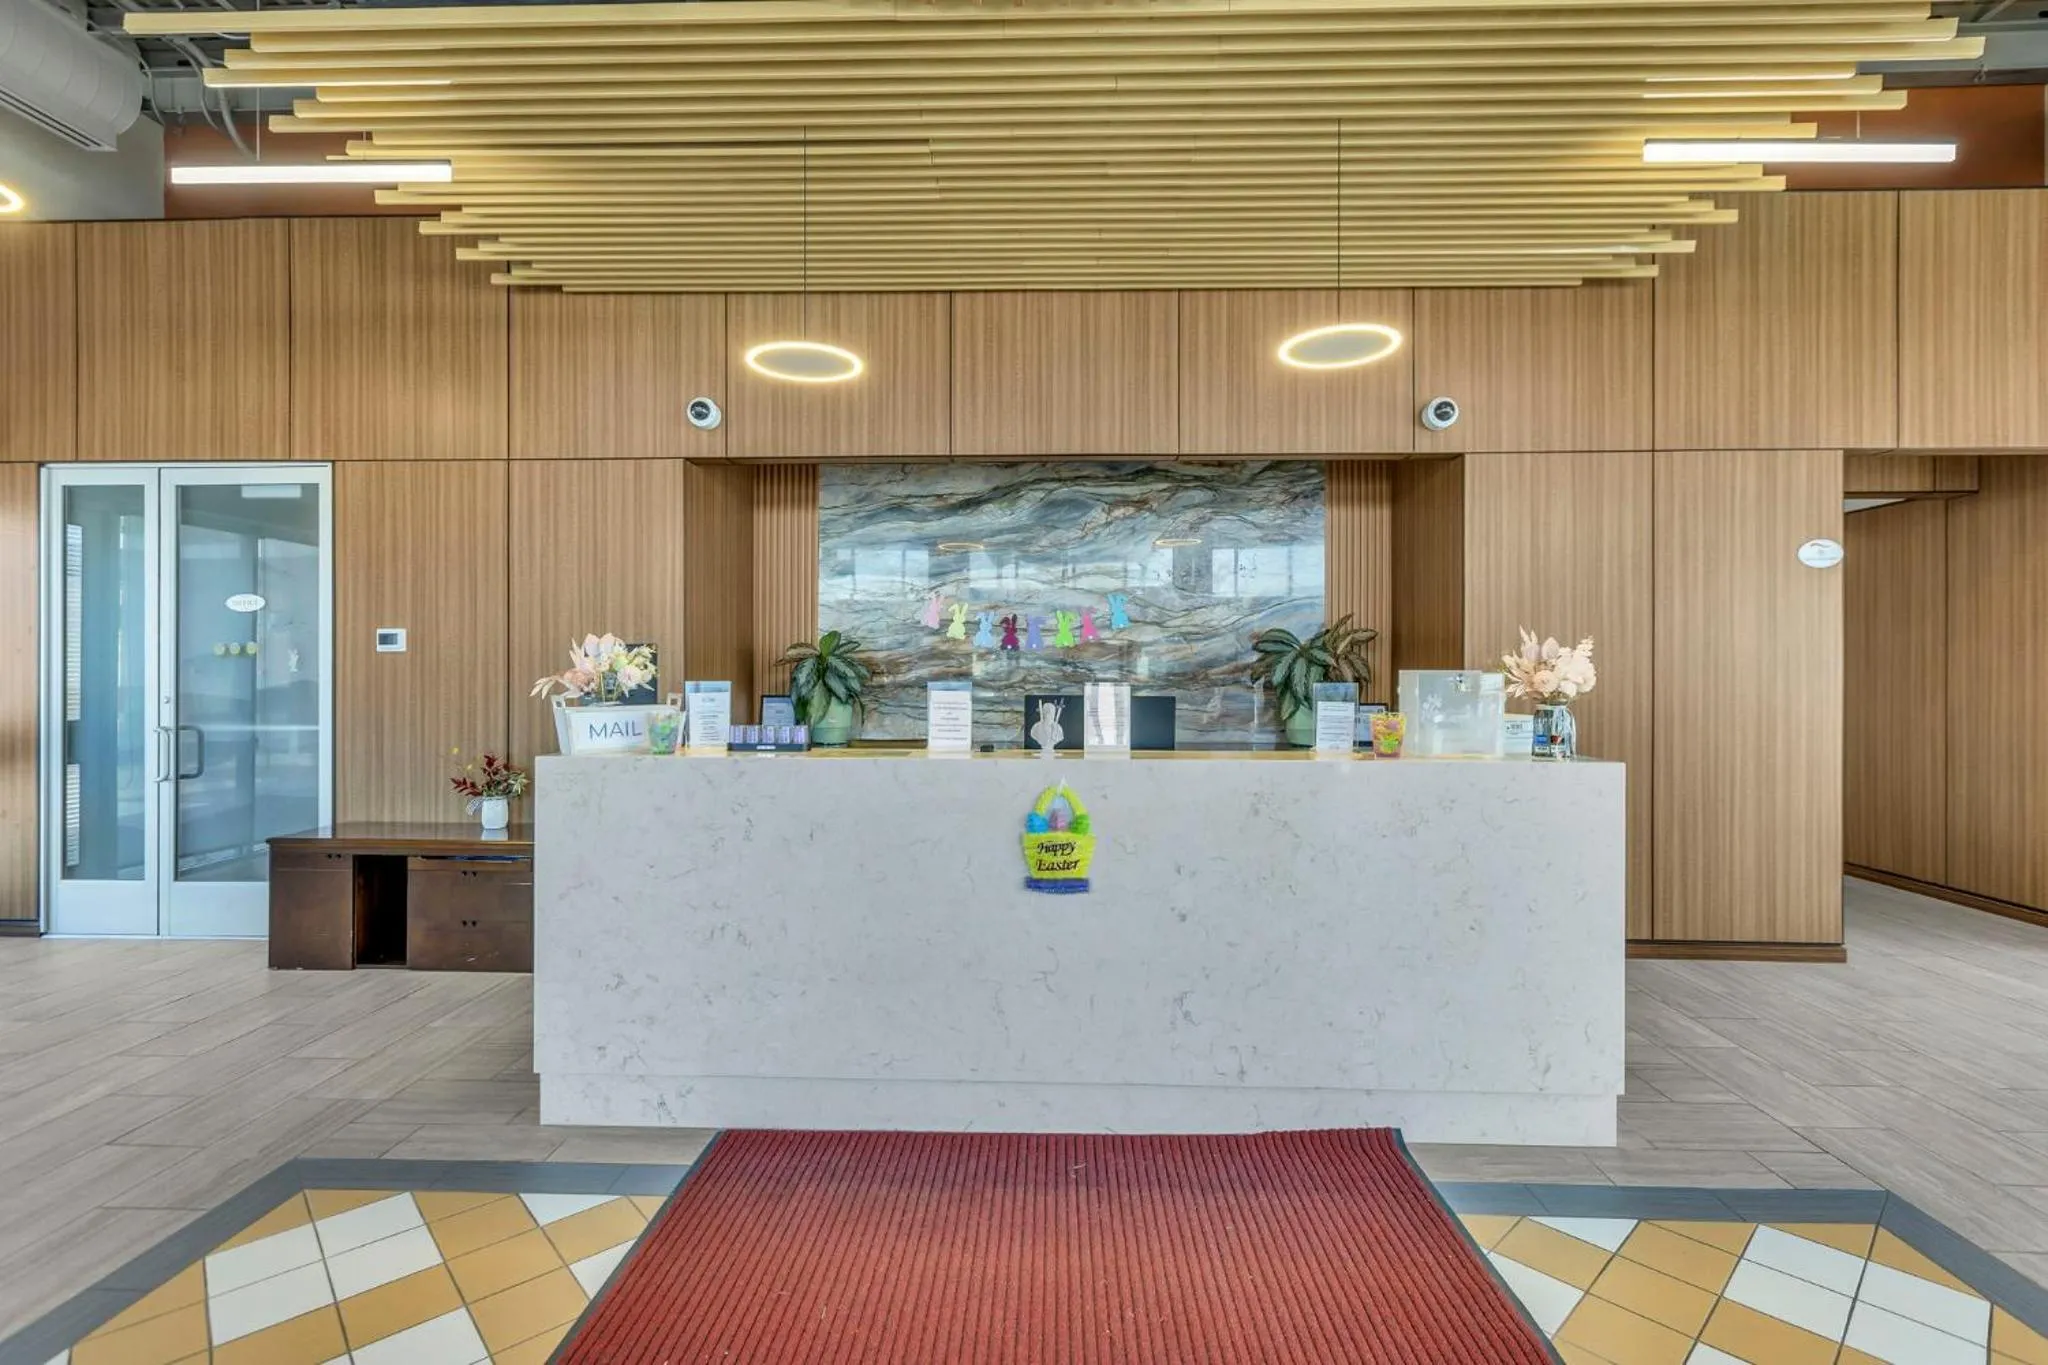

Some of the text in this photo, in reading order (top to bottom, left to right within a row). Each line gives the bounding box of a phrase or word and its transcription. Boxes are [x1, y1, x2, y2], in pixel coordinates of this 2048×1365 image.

[589, 720, 643, 740] MAIL
[1036, 841, 1076, 857] Happy
[1035, 859, 1080, 871] Easter
